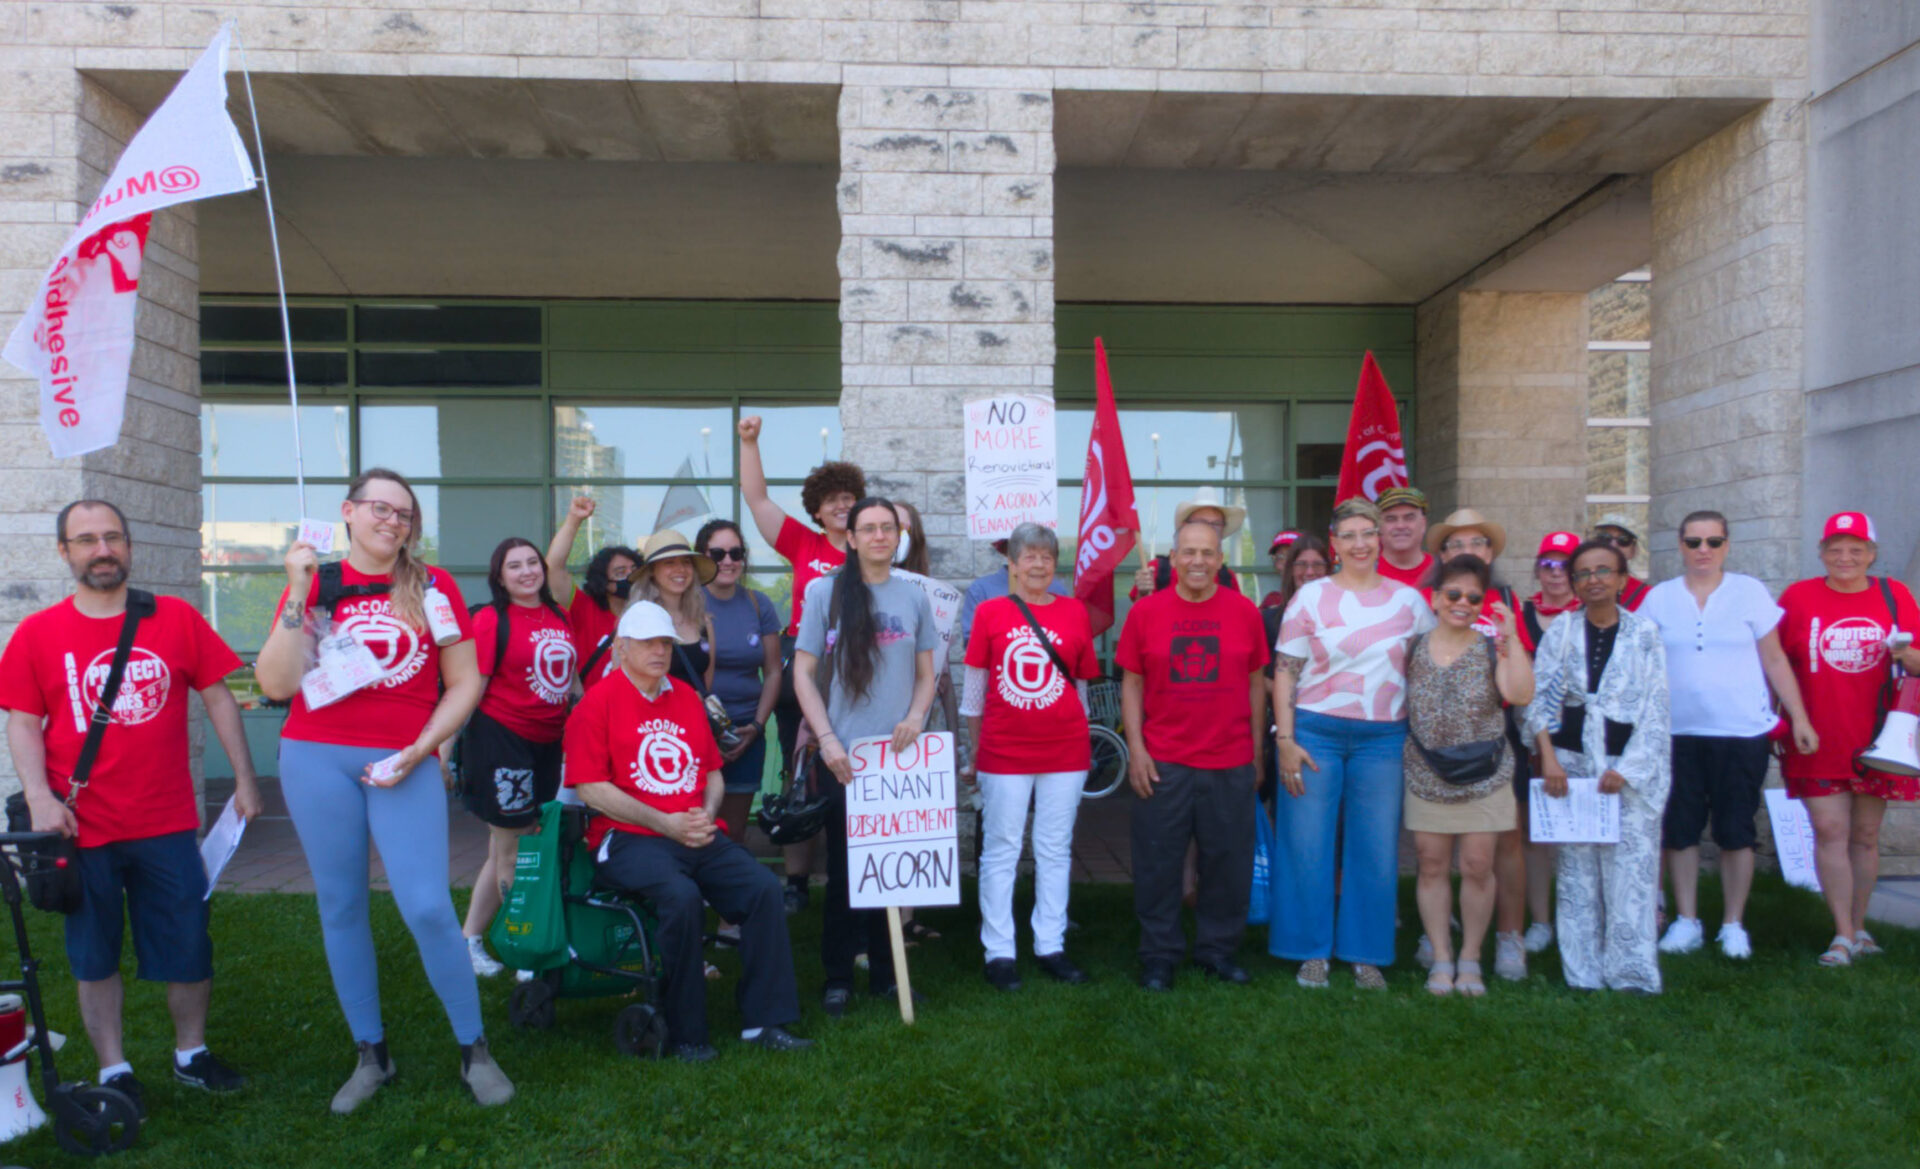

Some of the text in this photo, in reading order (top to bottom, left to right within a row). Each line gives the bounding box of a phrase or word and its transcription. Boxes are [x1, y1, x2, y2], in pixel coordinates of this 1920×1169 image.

[987, 400, 1026, 425] NO
[974, 426, 1043, 450] MORE
[993, 492, 1038, 510] ACORN
[1172, 619, 1221, 633] ACORN
[1825, 626, 1882, 641] PROTECT
[88, 658, 162, 687] PRTECT
[384, 651, 429, 688] UNION
[996, 673, 1067, 711] TENANT UNION
[852, 734, 945, 772] STOP
[852, 770, 951, 802] TENANT
[848, 807, 957, 838] DISPLACEMENT
[857, 846, 954, 894] ACORN
